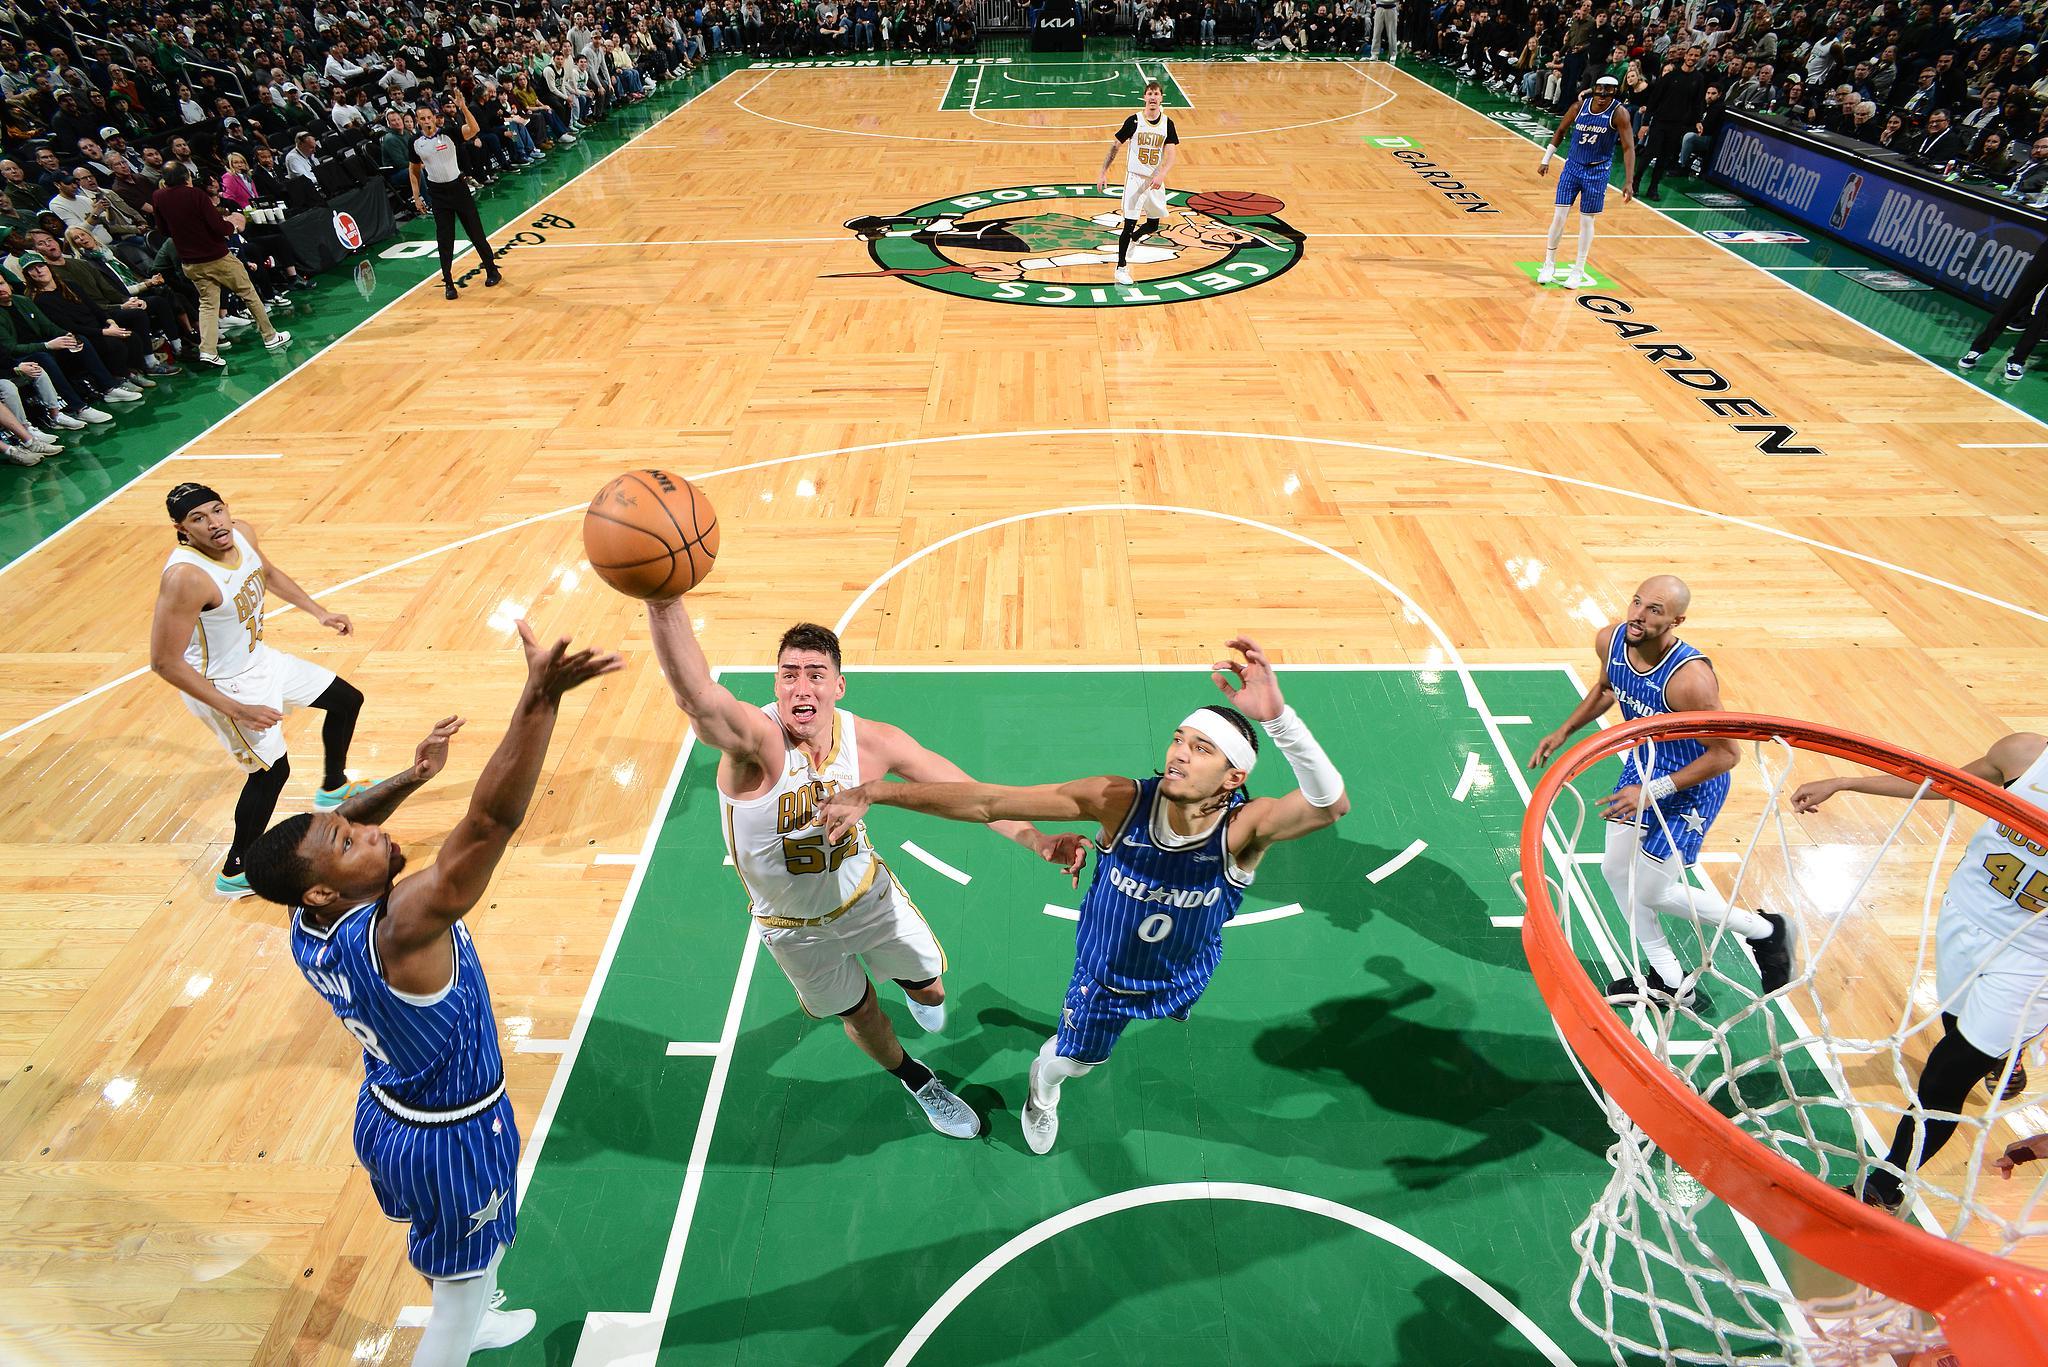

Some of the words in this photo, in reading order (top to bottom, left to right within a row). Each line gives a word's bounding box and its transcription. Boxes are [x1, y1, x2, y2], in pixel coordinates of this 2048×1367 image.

[748, 59, 880, 69] BOSTON
[892, 57, 1013, 66] CELTICS
[1138, 147, 1160, 165] 55
[1578, 133, 1598, 145] 34
[1391, 150, 1503, 214] GARDEN
[1714, 128, 1821, 212] NBAStore.com
[991, 262, 1270, 303] CELTICS
[1575, 294, 1827, 456] GARDEN
[782, 825, 859, 876] 52
[1137, 913, 1174, 943] 0
